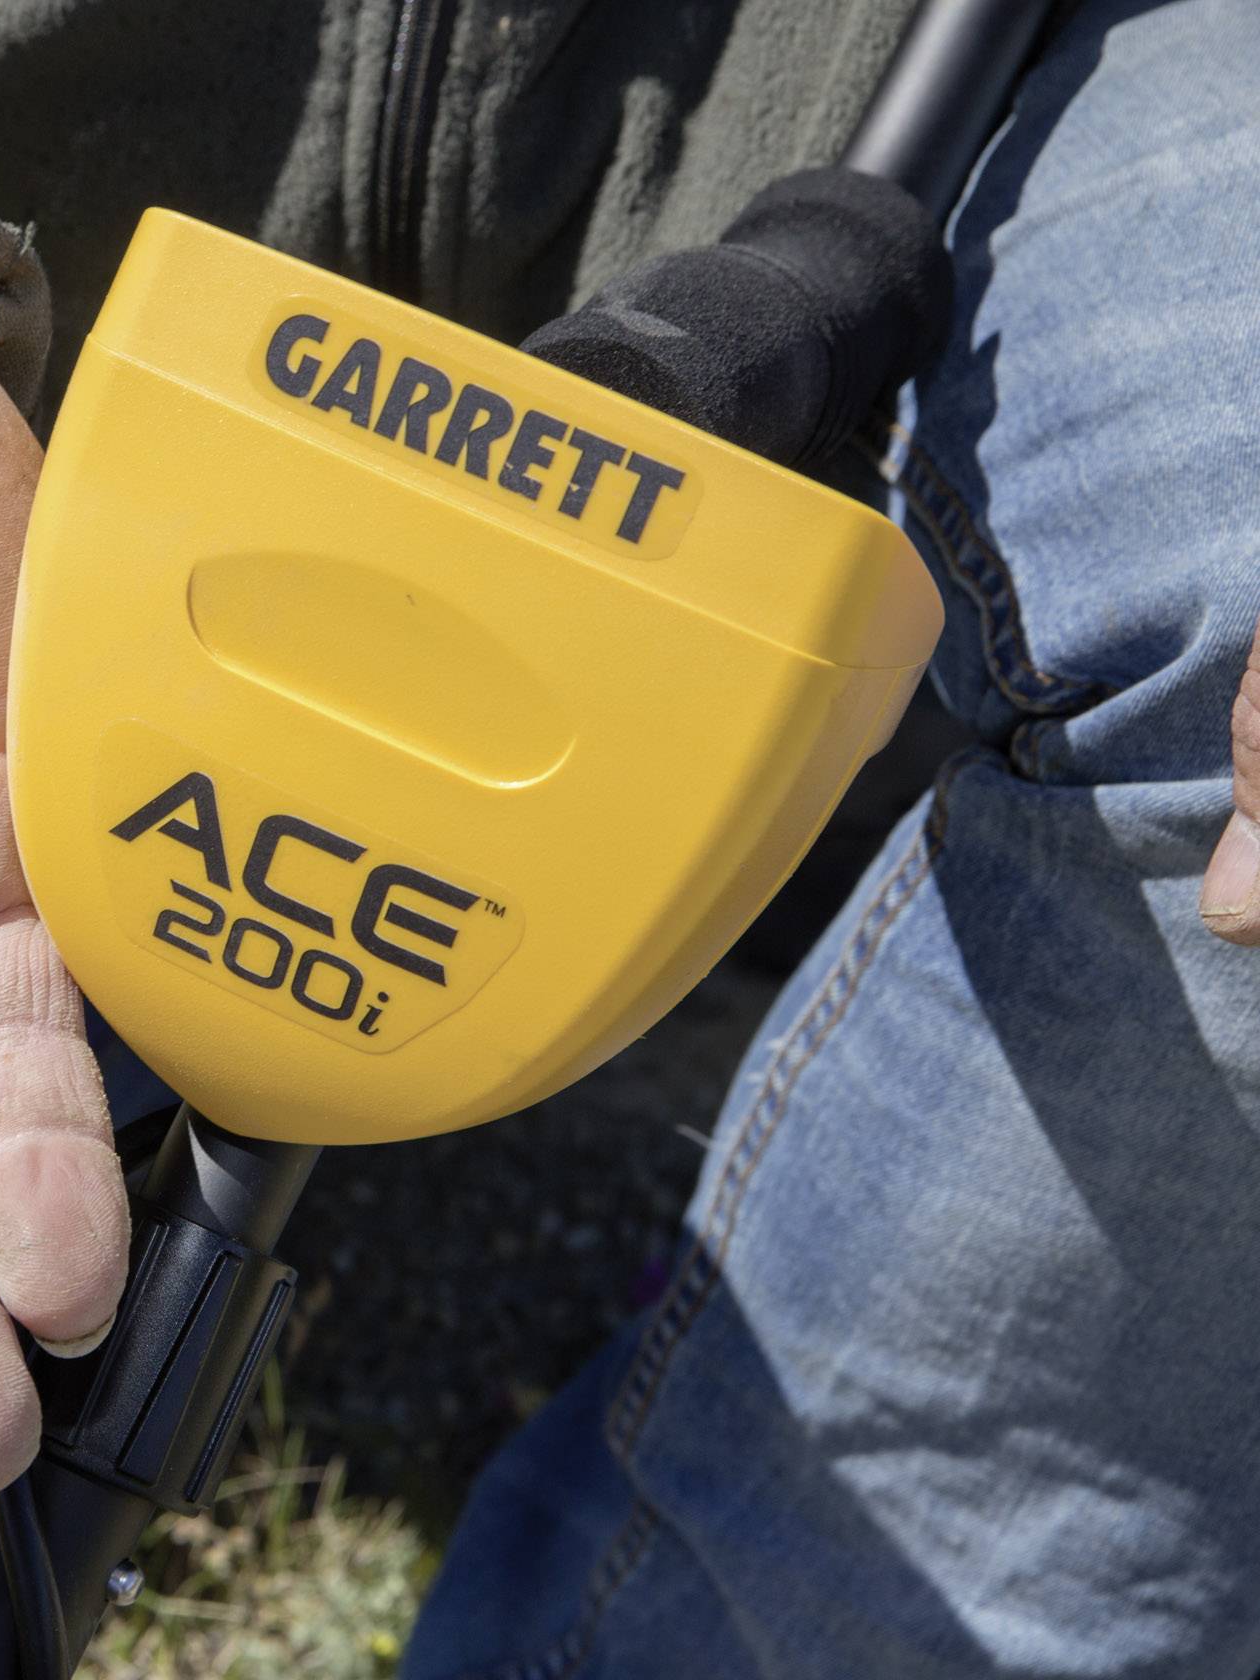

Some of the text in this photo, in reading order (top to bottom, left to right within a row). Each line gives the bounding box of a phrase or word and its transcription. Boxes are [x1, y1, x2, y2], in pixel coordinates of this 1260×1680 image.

[265, 313, 686, 544] GARRETT
[108, 771, 481, 988] ACE
[152, 879, 390, 1037] 200i
